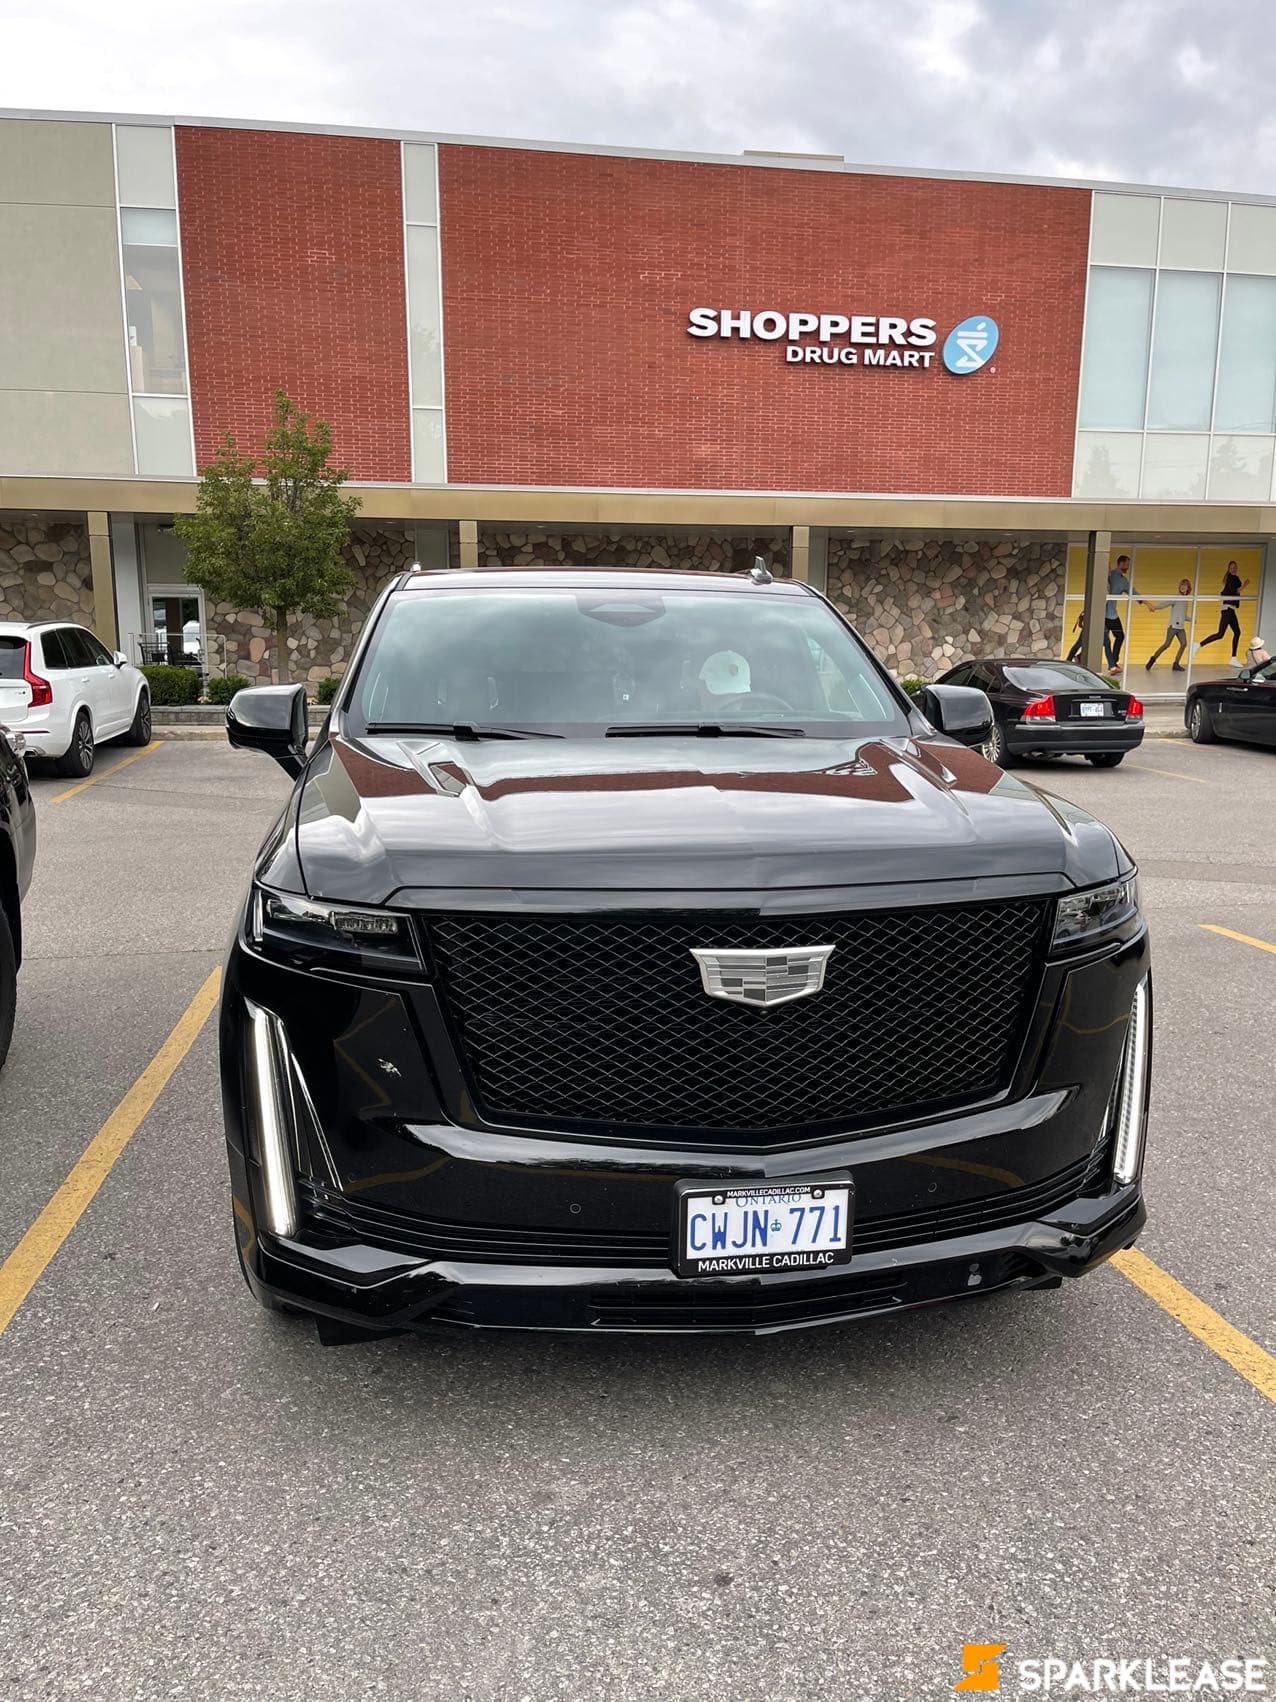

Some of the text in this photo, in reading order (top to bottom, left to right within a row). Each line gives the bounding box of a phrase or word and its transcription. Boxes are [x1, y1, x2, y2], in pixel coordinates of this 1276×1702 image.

[687, 307, 937, 346] SHOPPERS
[786, 346, 935, 368] DRUG MART
[727, 1186, 811, 1197] MARKVILLECADILLAC.COM
[735, 1194, 802, 1208] ONTARIO
[689, 1205, 841, 1251] CWJN 771
[698, 1252, 834, 1272] MARKVILLE CADILLAC
